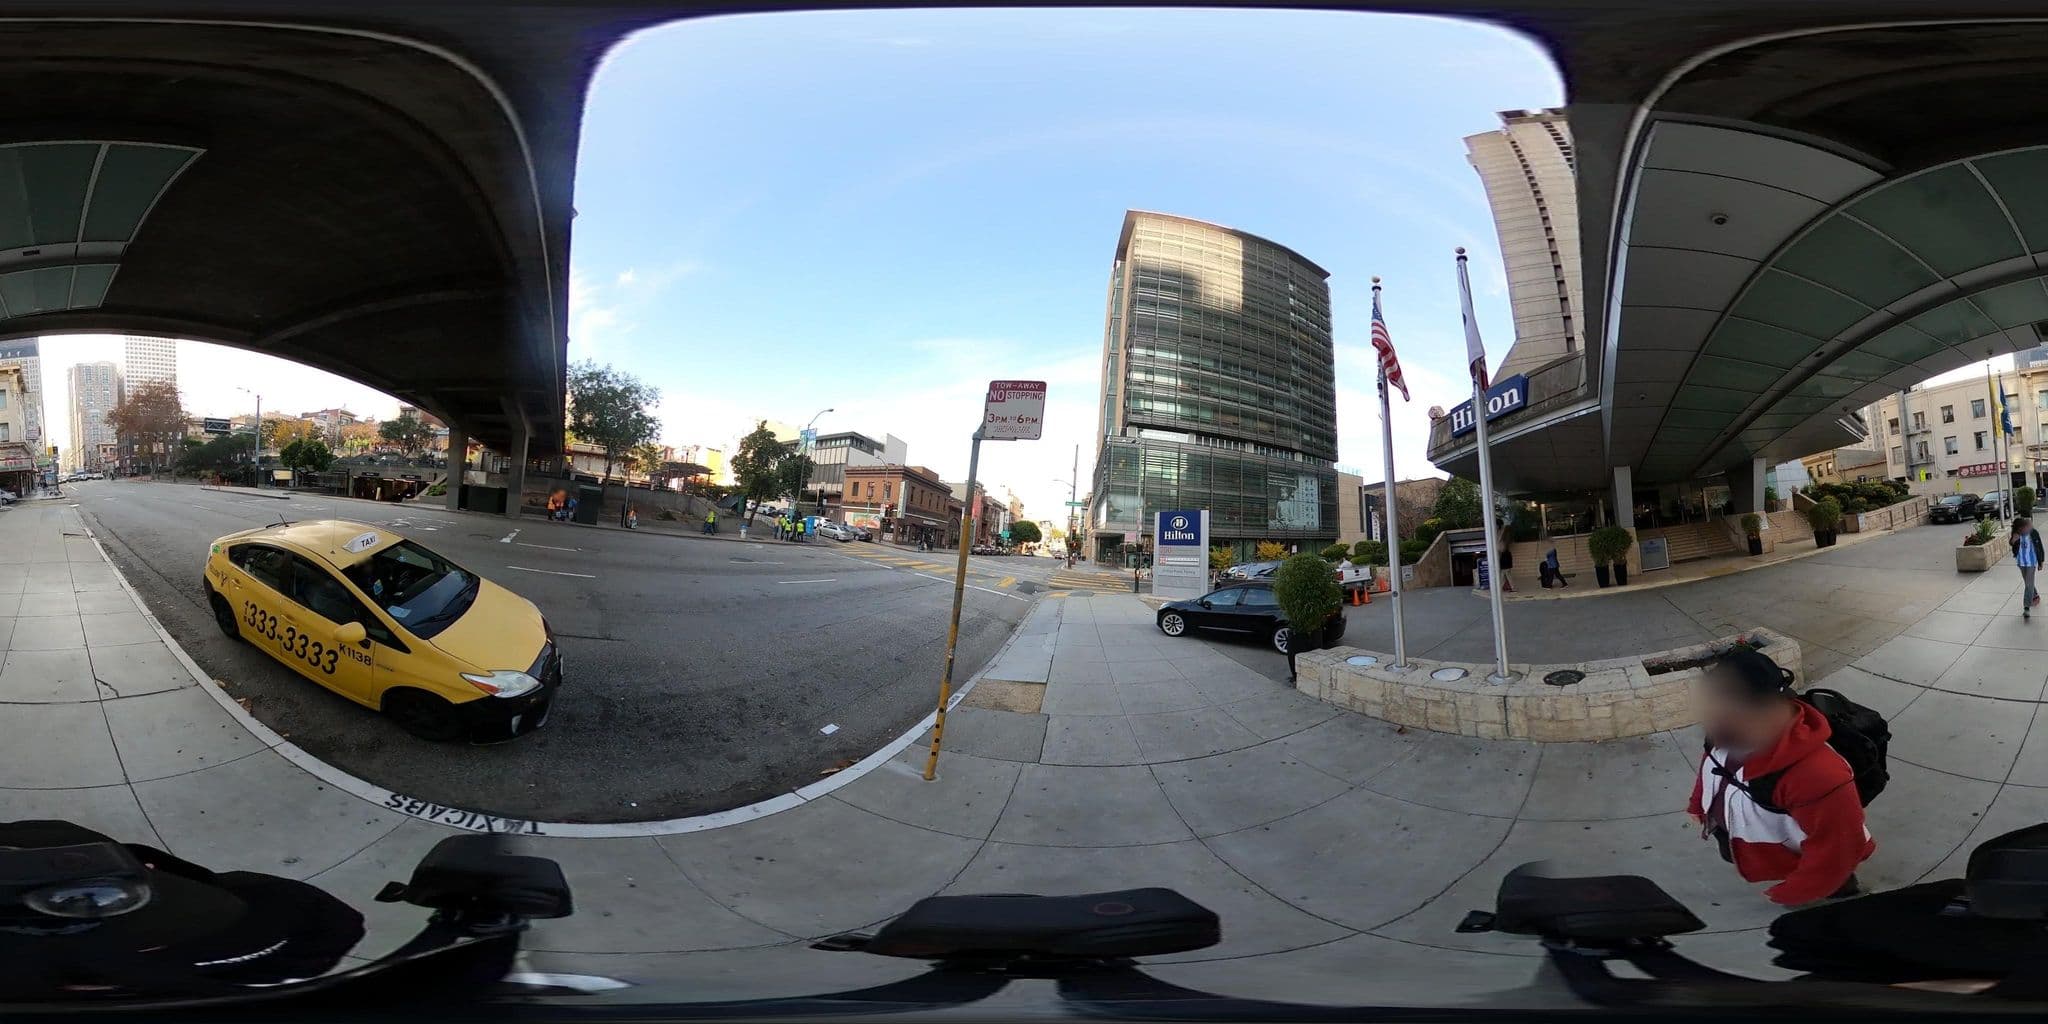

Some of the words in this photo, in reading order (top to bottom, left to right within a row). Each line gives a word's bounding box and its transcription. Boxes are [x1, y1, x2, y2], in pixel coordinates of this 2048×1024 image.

[990, 390, 1005, 401] NO
[1007, 392, 1042, 400] STOPPING
[1452, 388, 1520, 432] Hion
[361, 536, 376, 547] TAXI
[1164, 530, 1194, 540] Hilton
[248, 603, 339, 675] 333-3333
[339, 642, 372, 666] K1138
